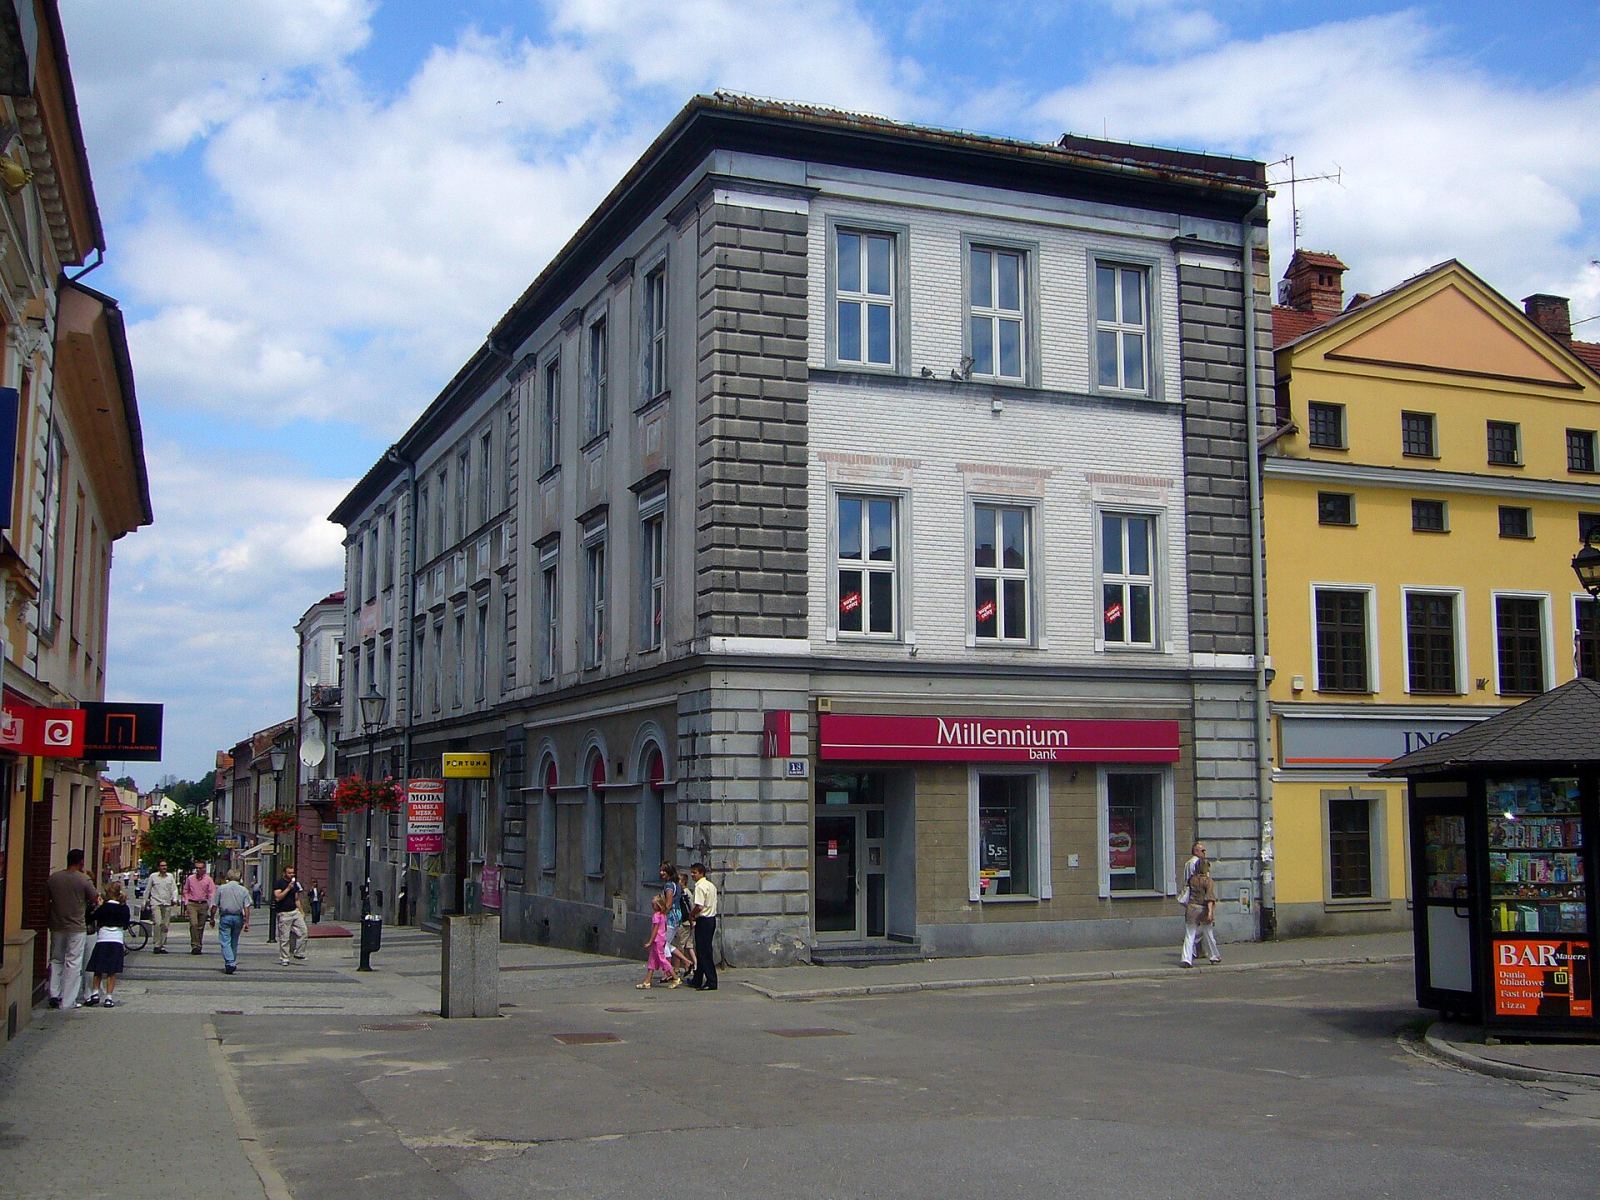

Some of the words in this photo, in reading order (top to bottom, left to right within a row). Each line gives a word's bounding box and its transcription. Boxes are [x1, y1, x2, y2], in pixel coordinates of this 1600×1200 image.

[937, 717, 1068, 746] Millennium
[768, 729, 778, 758] M
[1029, 748, 1057, 760] bank
[411, 794, 441, 802] MODA
[1499, 944, 1558, 967] BAR
[1499, 971, 1526, 979] Dania
[1500, 978, 1545, 987] obiadowe
[1501, 990, 1520, 998] Fast
[1522, 990, 1545, 999] food
